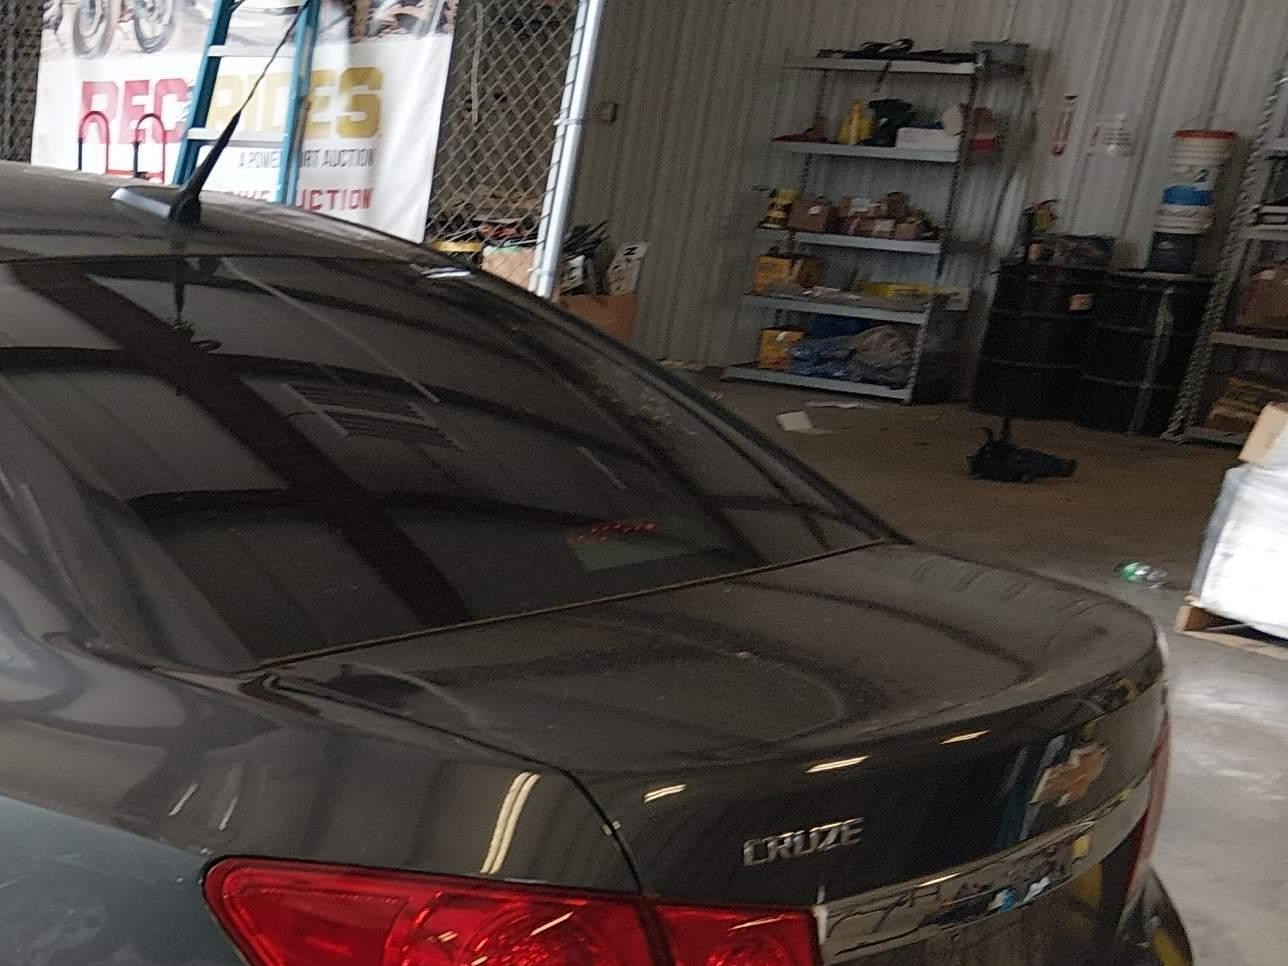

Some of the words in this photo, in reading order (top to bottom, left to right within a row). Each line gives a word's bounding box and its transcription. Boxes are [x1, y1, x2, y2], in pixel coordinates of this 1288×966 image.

[78, 78, 190, 144] REC
[205, 67, 383, 139] RIDES
[321, 148, 376, 168] AUCTION
[296, 187, 375, 210] UCTION
[743, 817, 863, 867] CRUZE
